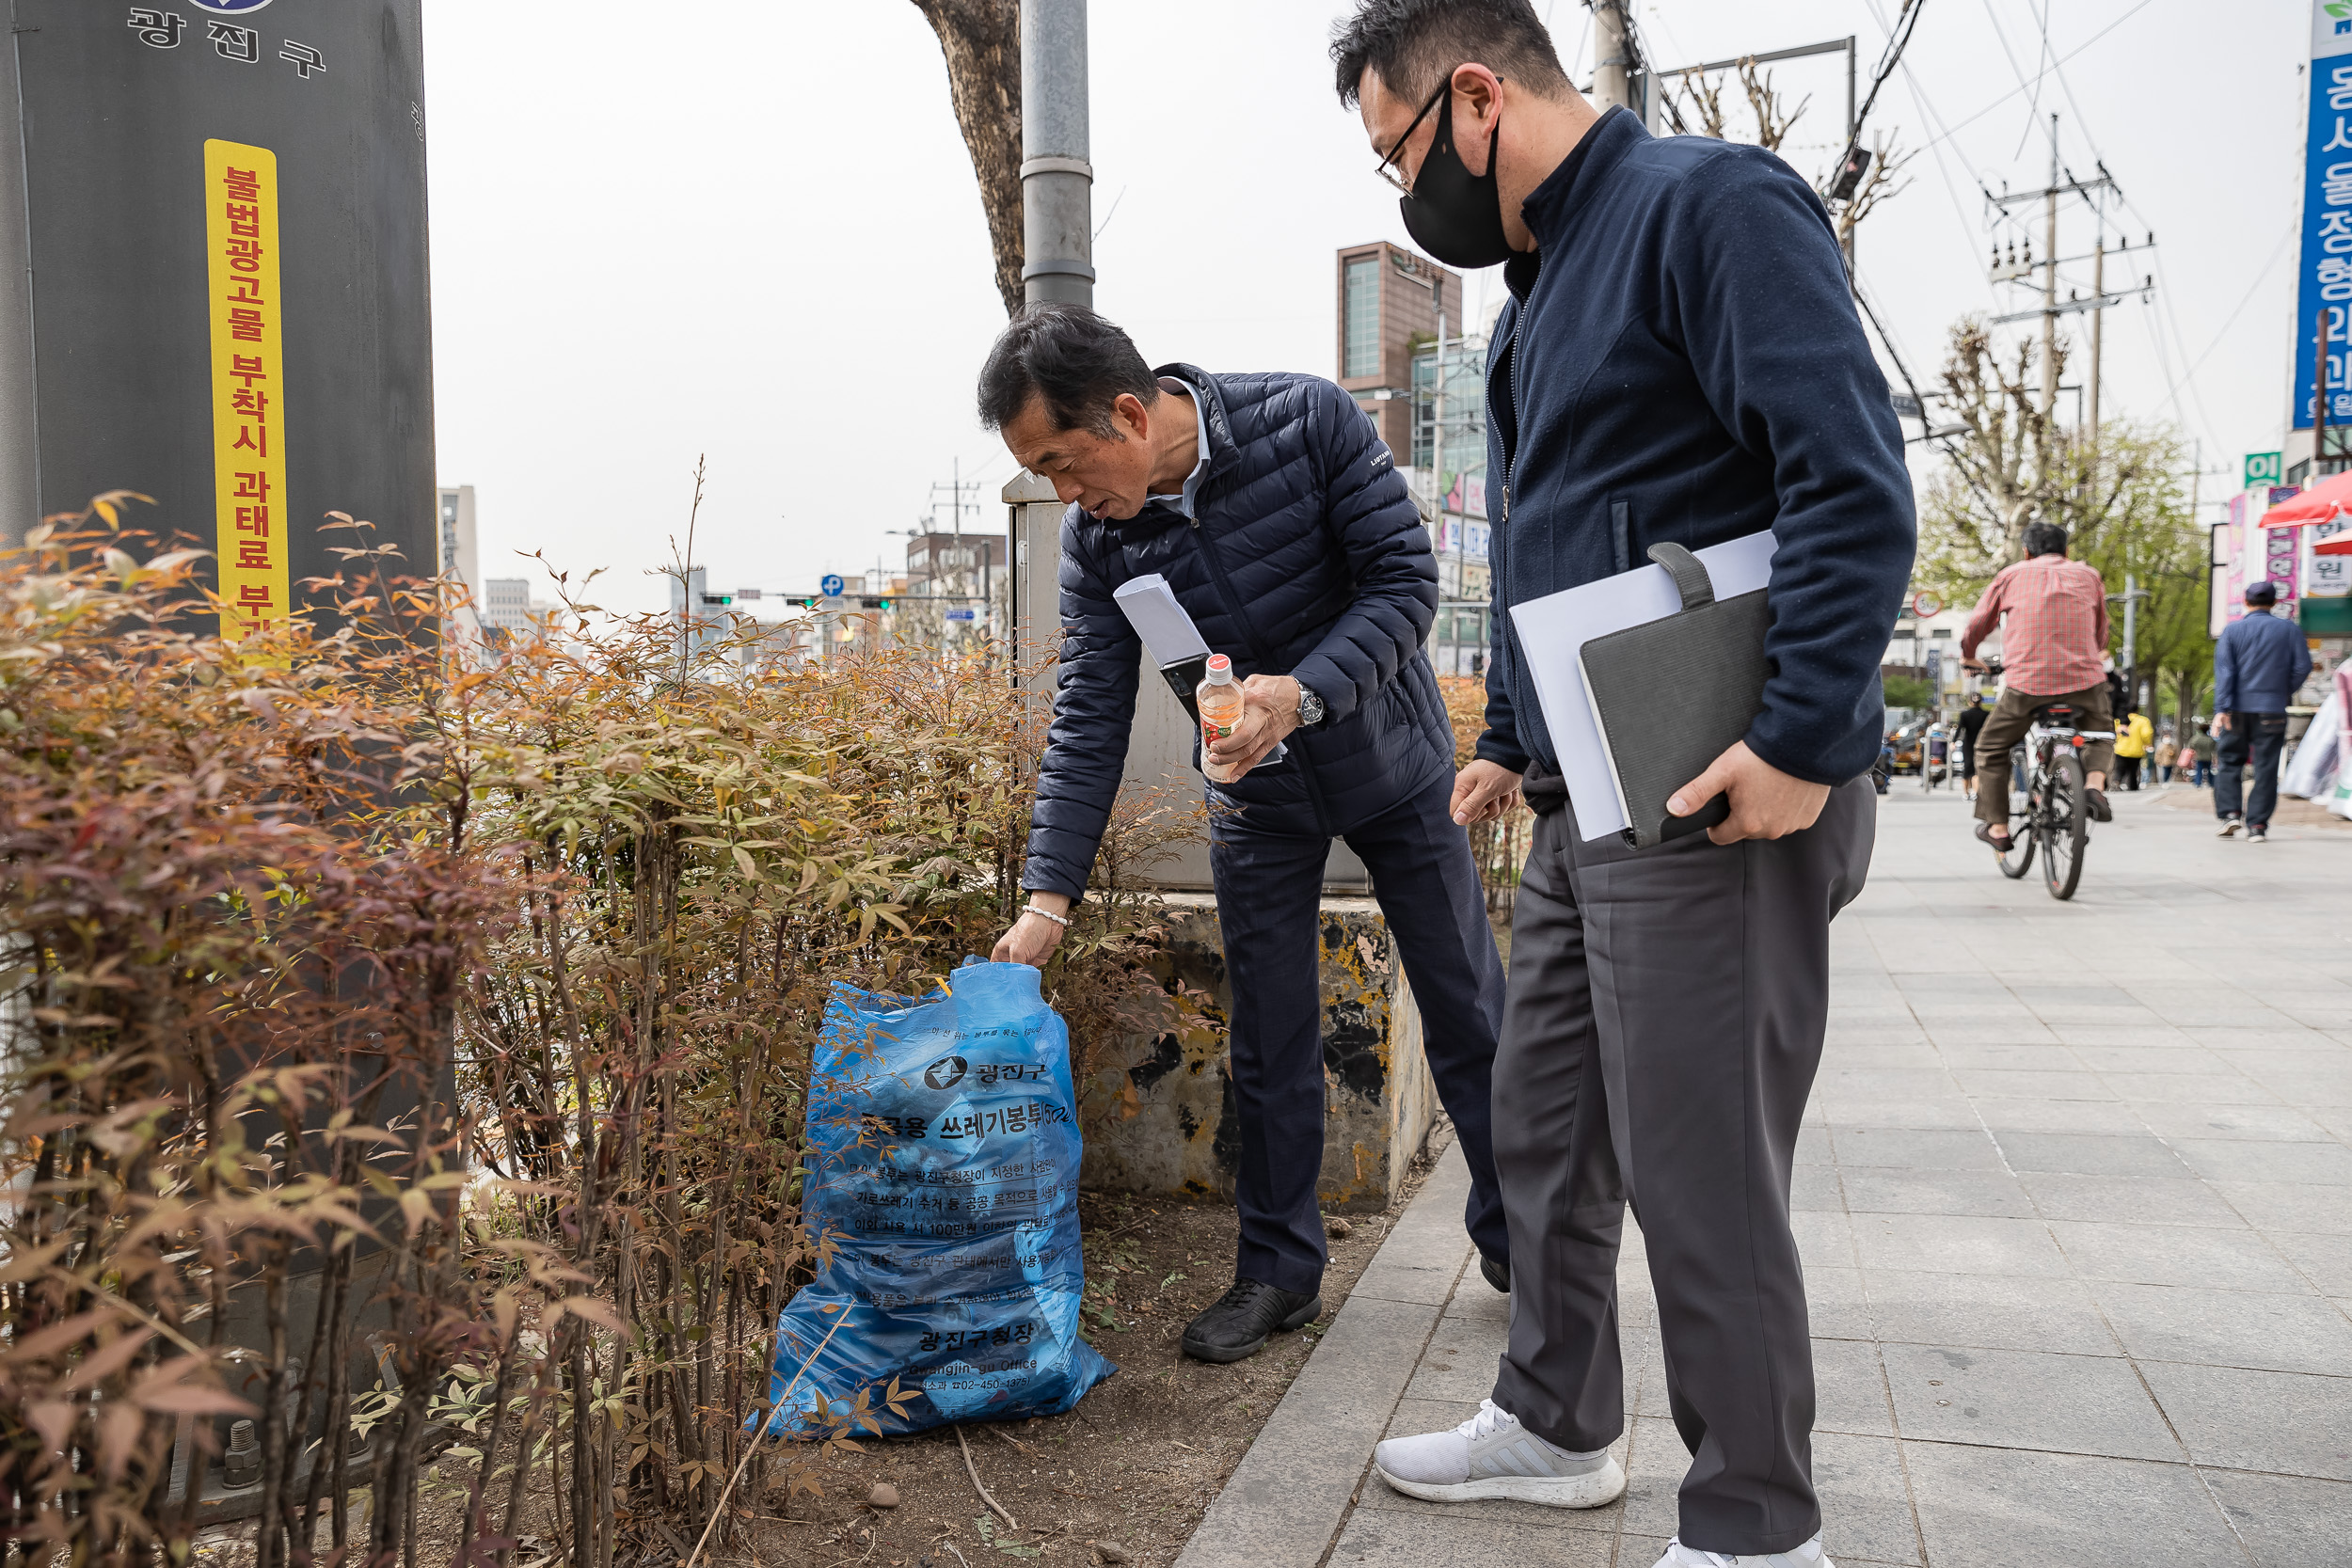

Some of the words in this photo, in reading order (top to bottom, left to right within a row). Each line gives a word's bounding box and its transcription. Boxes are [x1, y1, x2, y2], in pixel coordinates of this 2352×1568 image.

[127, 8, 326, 80] 광진구
[223, 166, 265, 342] 불법광고물
[230, 354, 269, 458] 부착시
[232, 470, 273, 570] 과태료
[976, 1064, 1047, 1083] 광진구
[876, 1166, 909, 1181] 봉투는
[914, 1167, 985, 1184] 광진구청장이
[991, 1163, 1025, 1180] 지정한
[857, 1192, 914, 1209] 가로쓰레기
[920, 1197, 943, 1211] 수거
[948, 1197, 959, 1211] 등
[966, 1195, 989, 1211] 공공
[993, 1189, 1039, 1205] 목적으로
[1041, 1183, 1058, 1199] 사용할
[854, 1219, 878, 1232] 이외
[883, 1220, 906, 1233] 사용
[912, 1223, 923, 1234] 시
[930, 1224, 977, 1236] 100만원
[870, 1253, 903, 1267] 봉투는
[910, 1255, 946, 1268] 광진구
[952, 1254, 1011, 1269] 관내에서만
[918, 1322, 1036, 1353] 광진구청장
[909, 1362, 995, 1377] Gwangjin-gu
[1000, 1358, 1038, 1372] Office
